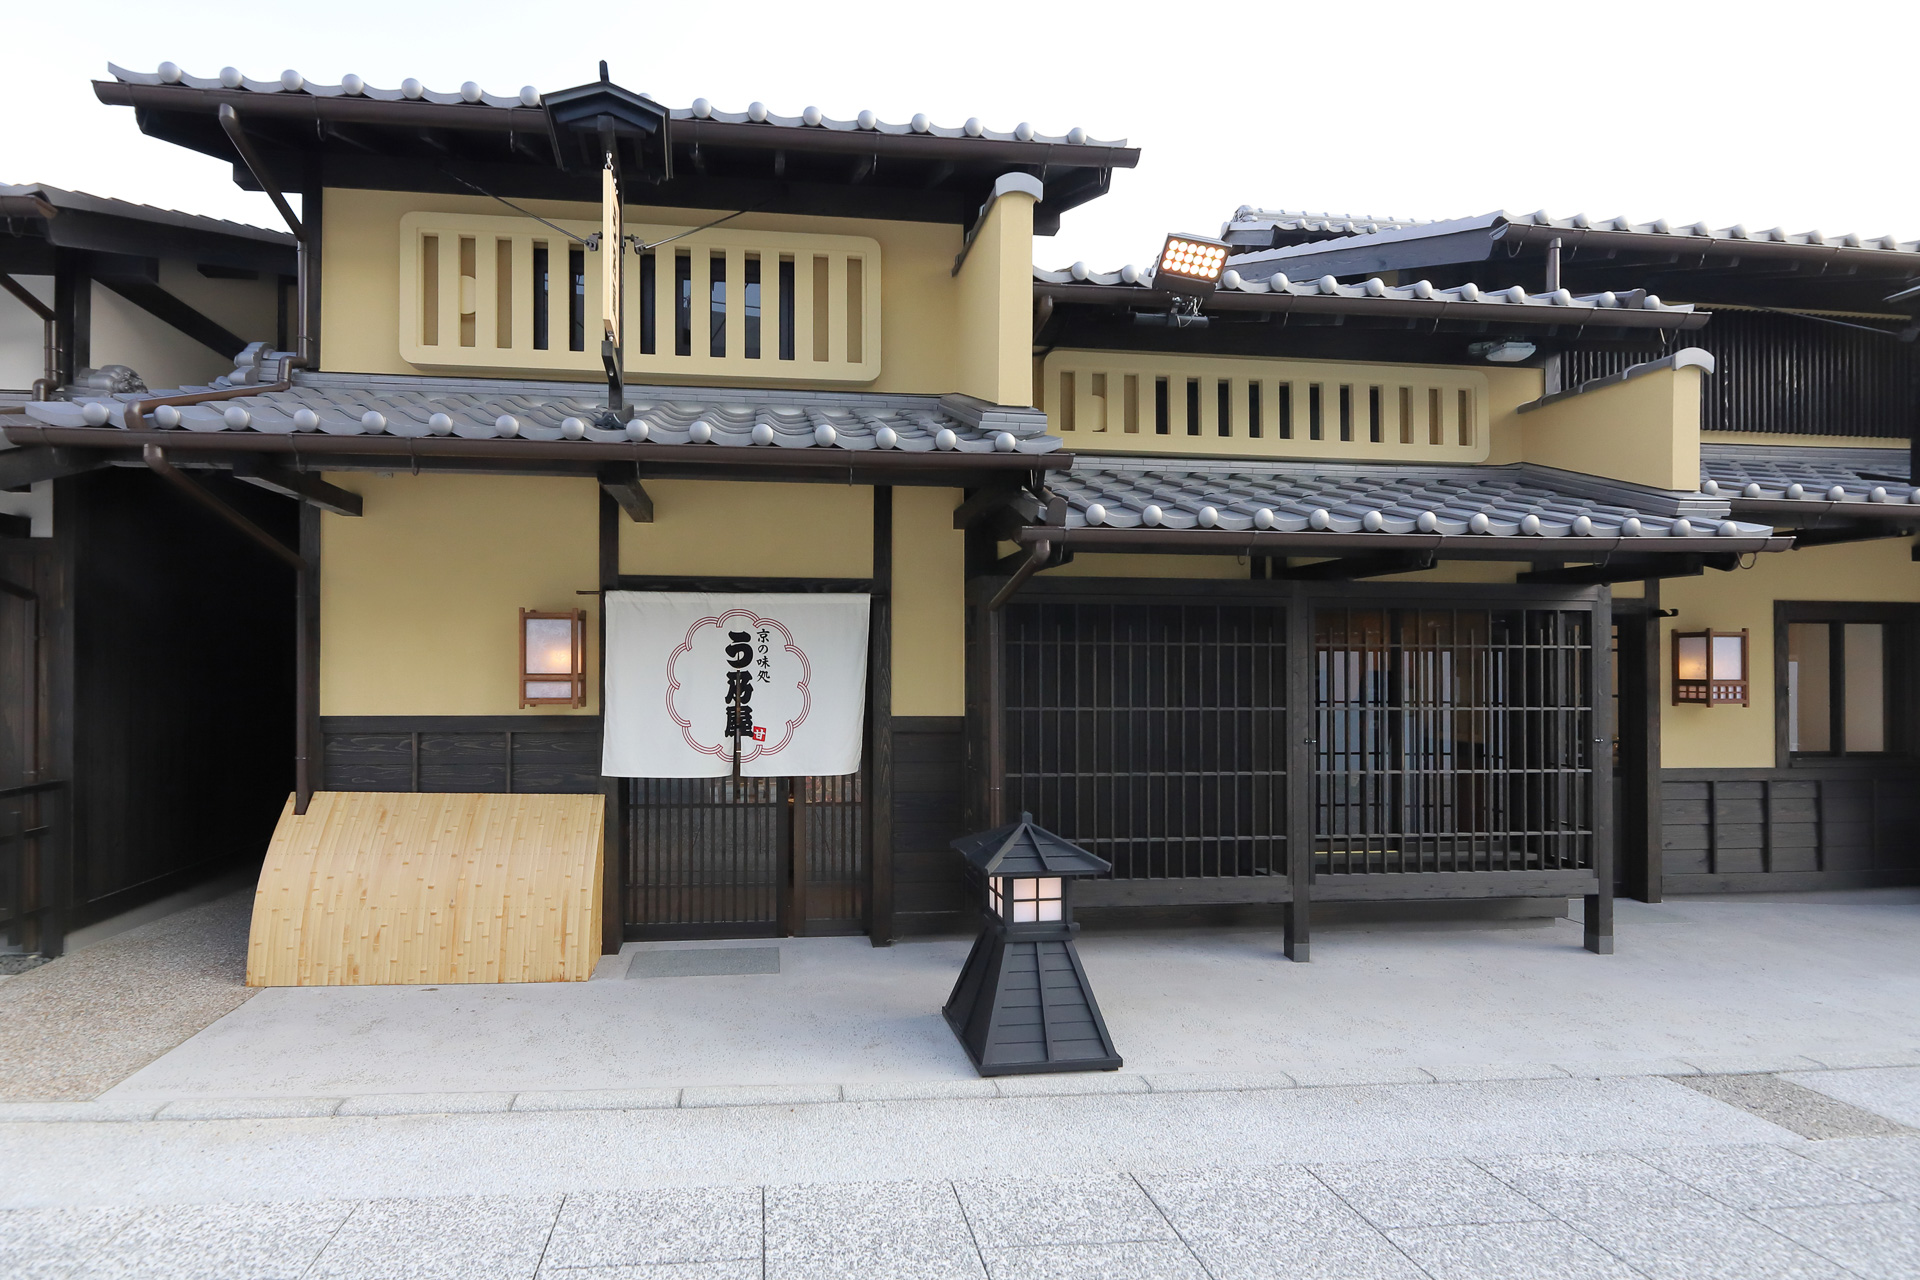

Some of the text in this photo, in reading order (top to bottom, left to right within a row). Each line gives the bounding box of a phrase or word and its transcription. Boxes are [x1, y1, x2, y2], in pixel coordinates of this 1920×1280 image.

[756, 628, 771, 684] 京の味処
[753, 728, 766, 740] 甘
